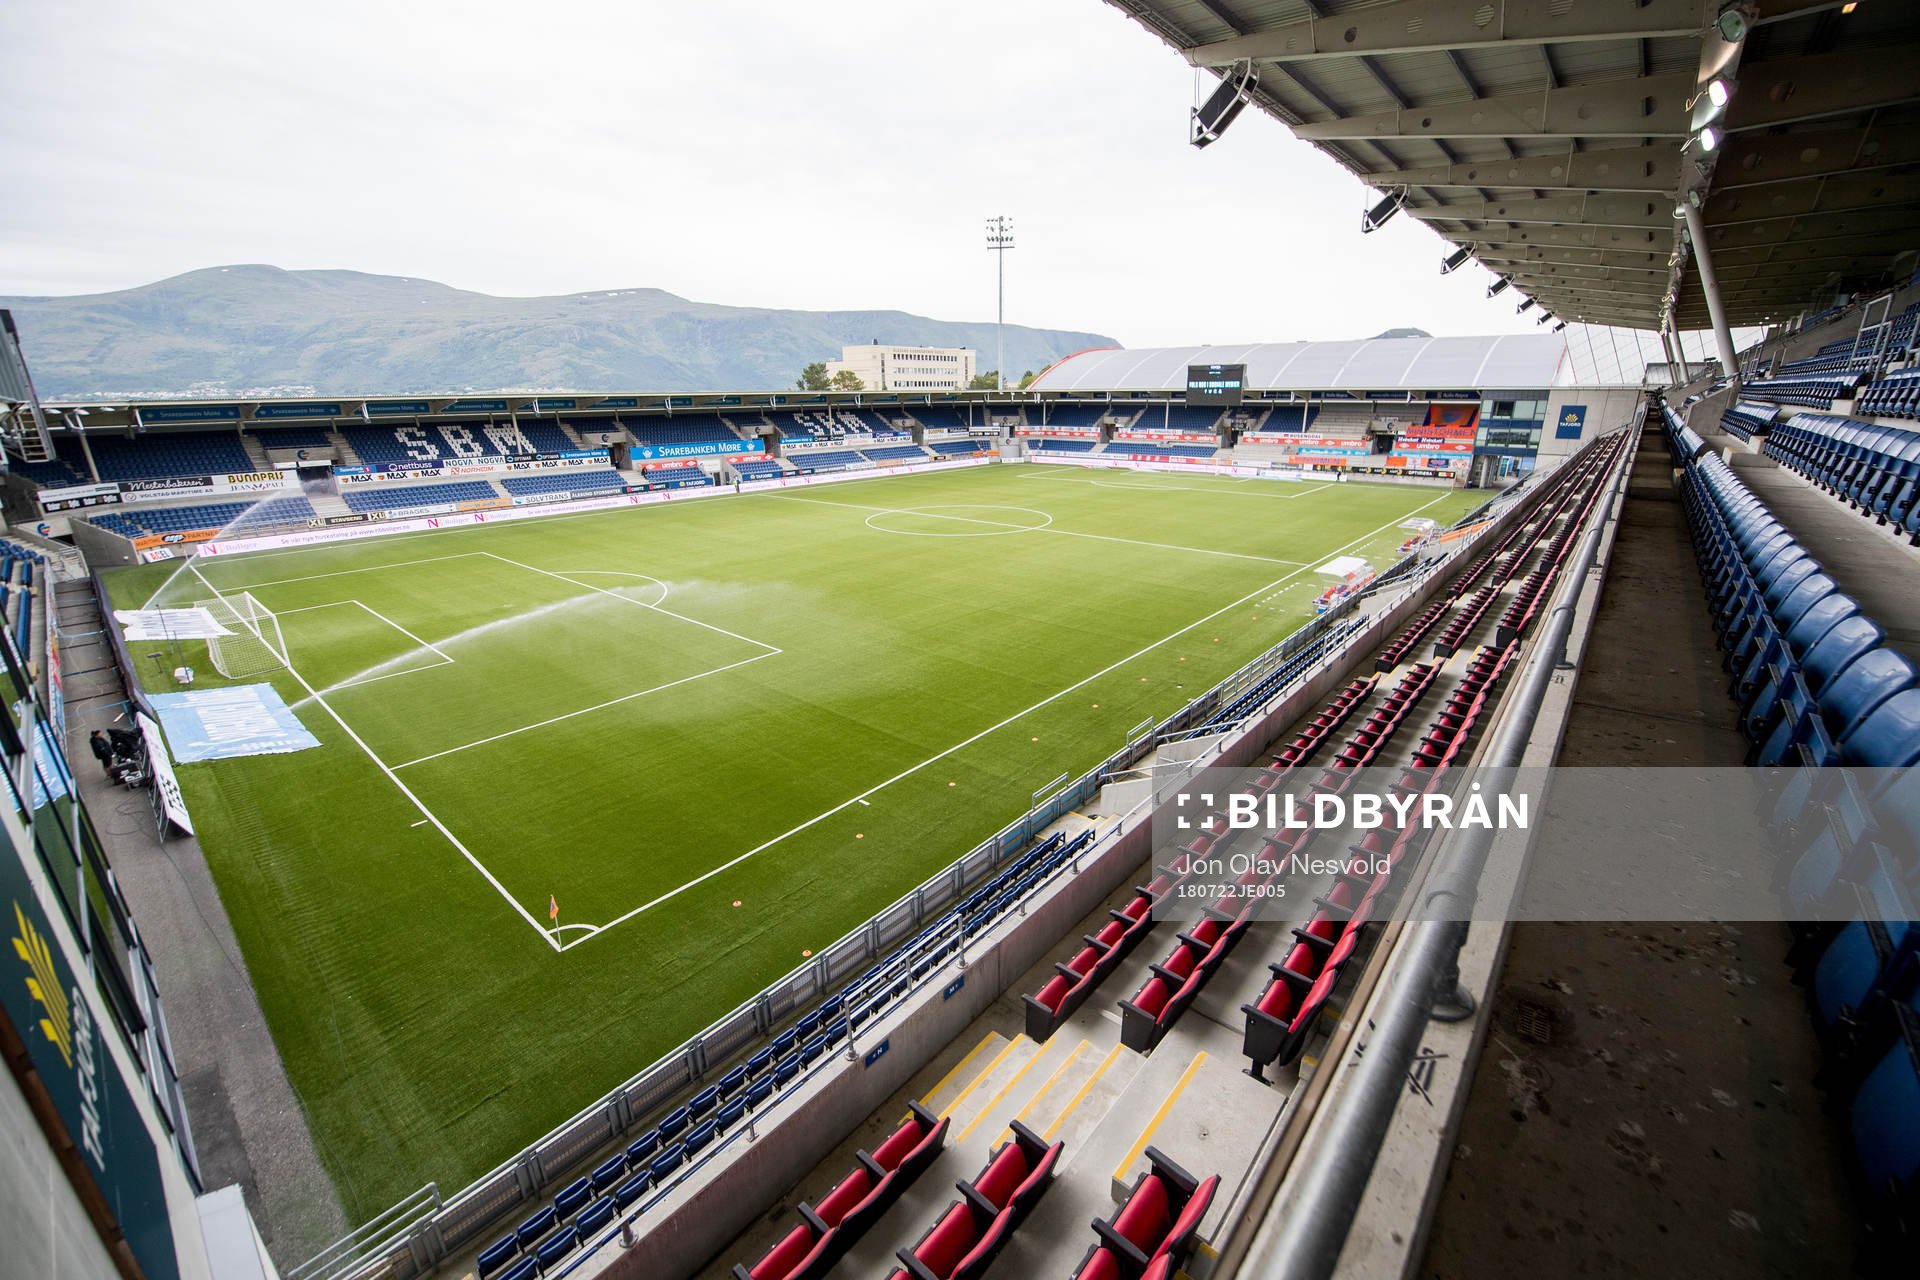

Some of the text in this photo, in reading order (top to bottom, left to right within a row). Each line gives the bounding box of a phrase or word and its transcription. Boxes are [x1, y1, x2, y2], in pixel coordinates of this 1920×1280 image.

[659, 443, 742, 457] SPAREBANKEN MØRE
[398, 462, 432, 470] nettbuss
[387, 472, 408, 480] MAX
[421, 469, 441, 477] MAX
[228, 472, 284, 484] BUNNPRIS
[351, 474, 373, 482] MAX
[526, 493, 569, 503] SOLVTRANS
[72, 986, 104, 1172] TAFJORD
